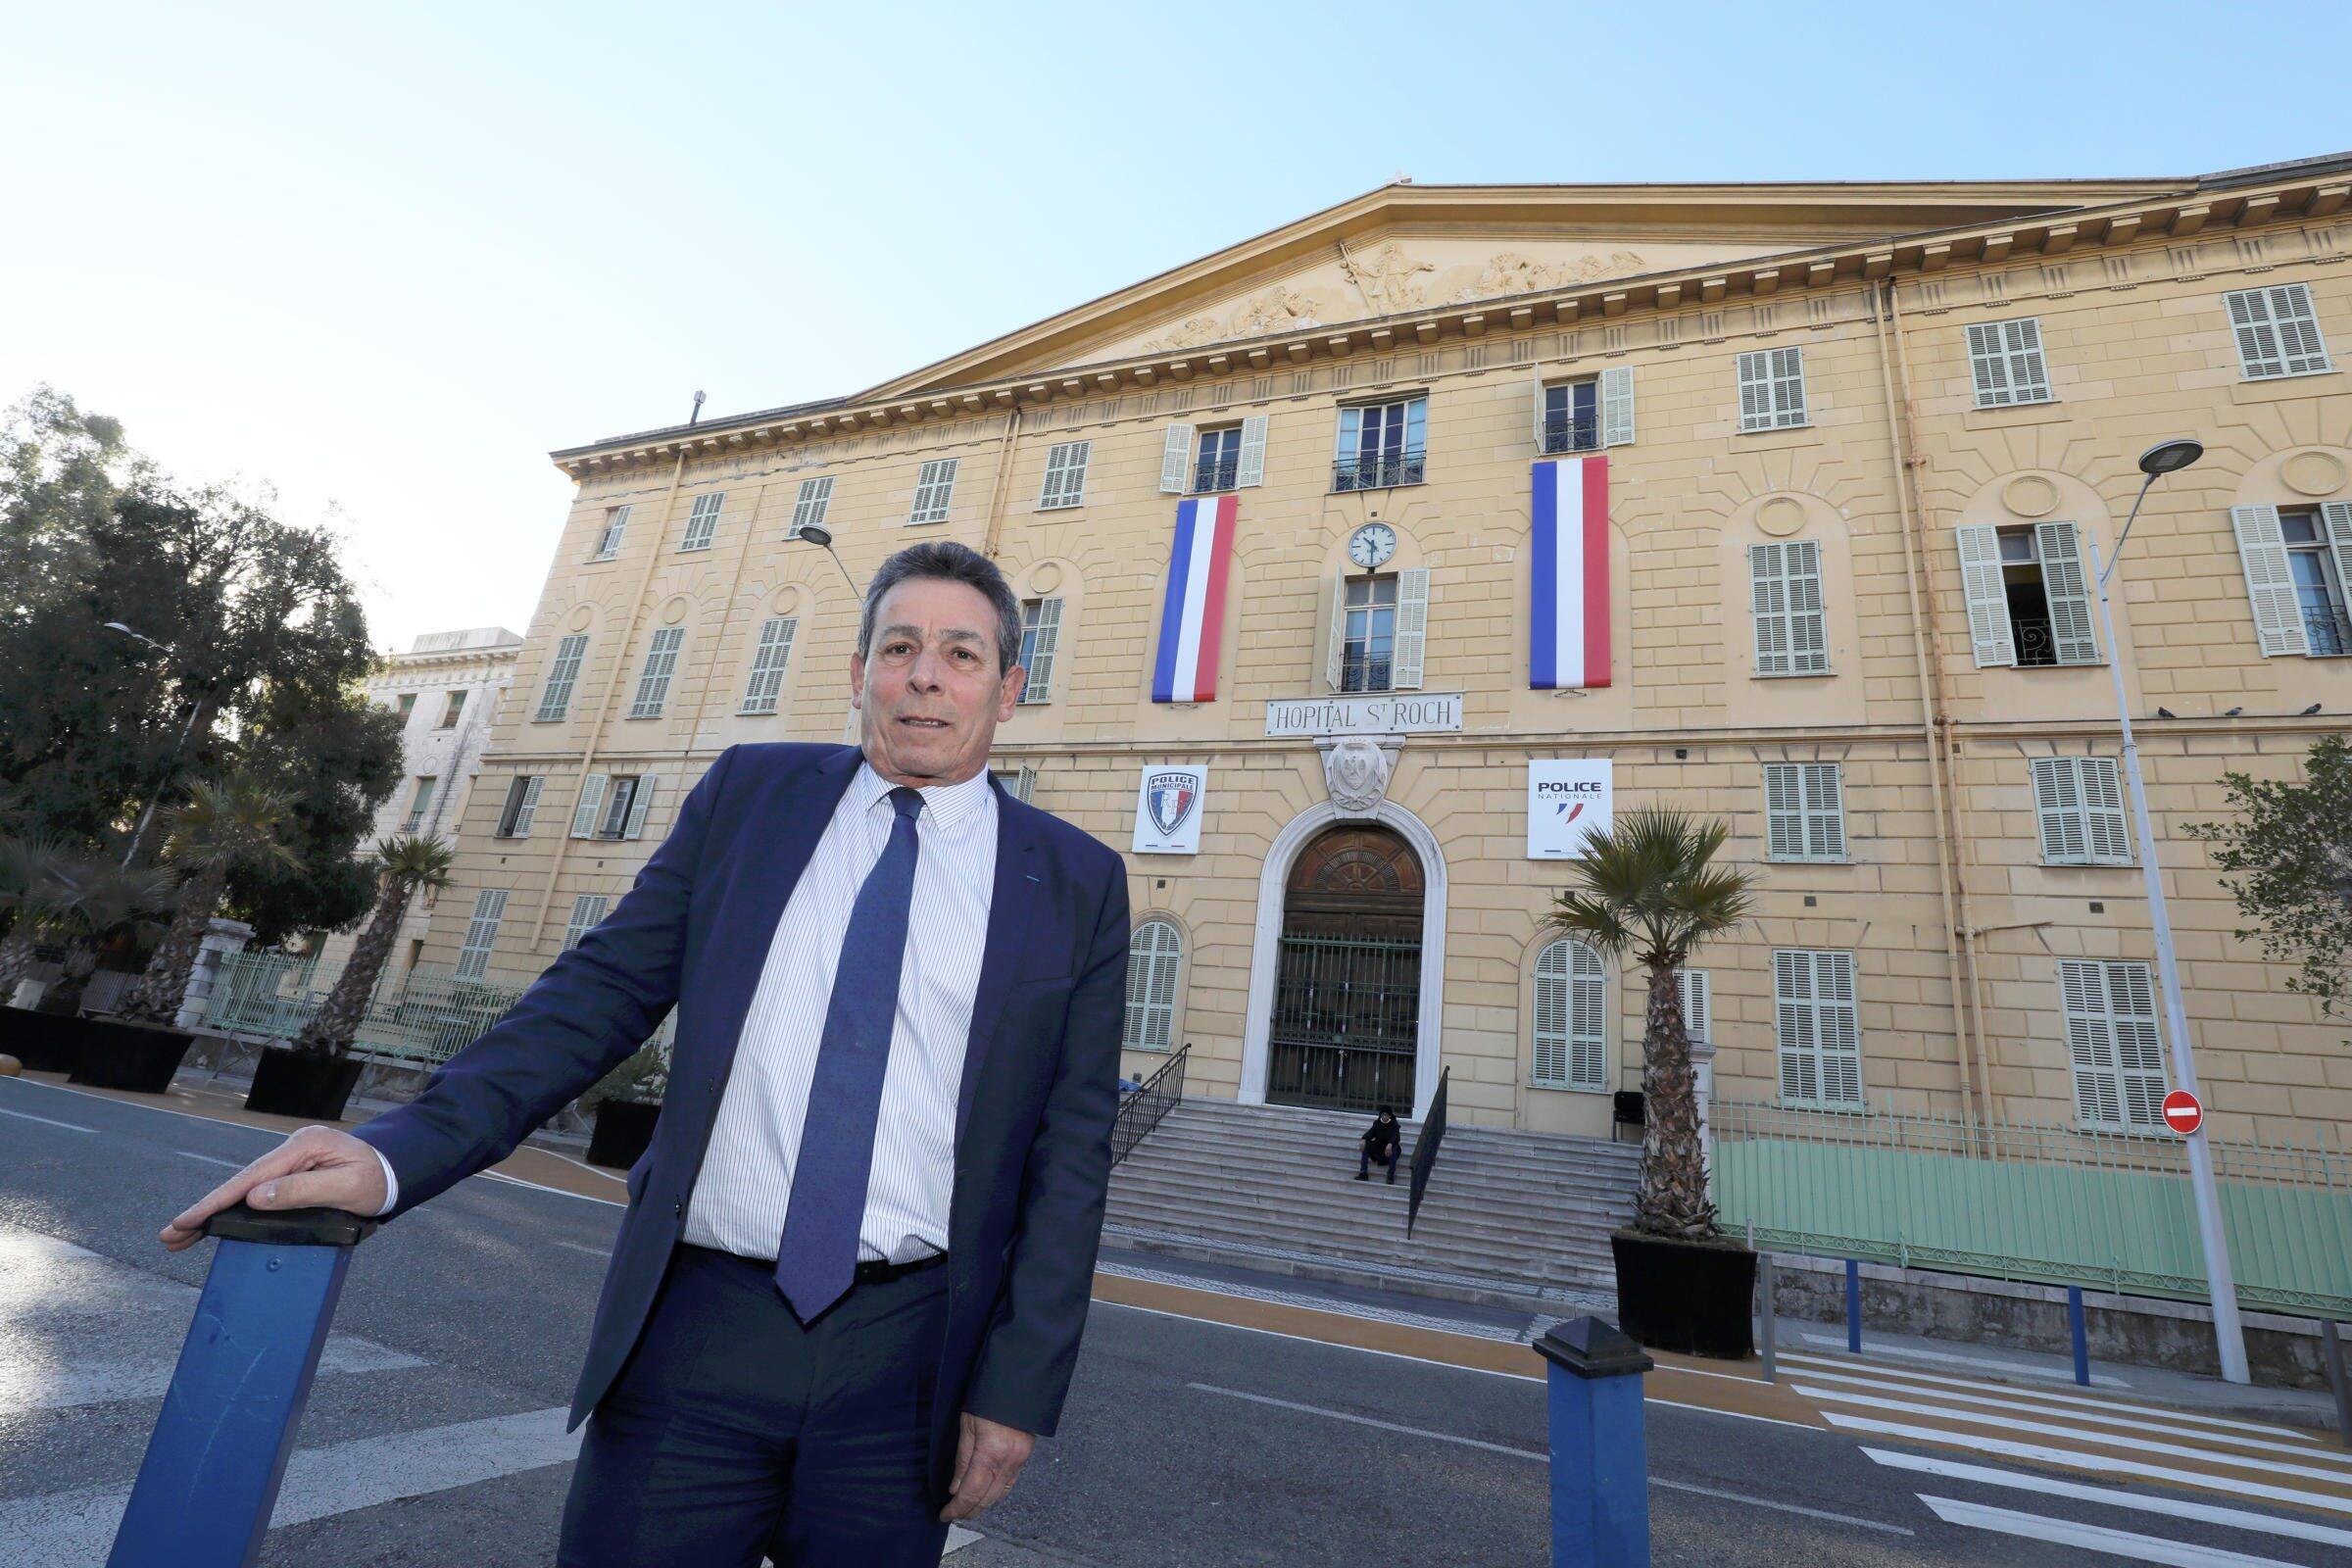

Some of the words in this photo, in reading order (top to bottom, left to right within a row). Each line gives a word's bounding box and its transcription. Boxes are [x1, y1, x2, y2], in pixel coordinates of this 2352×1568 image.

[1276, 705, 1356, 728] HOPITAL
[1394, 701, 1450, 725] ROCH
[1538, 782, 1601, 792] POLICE
